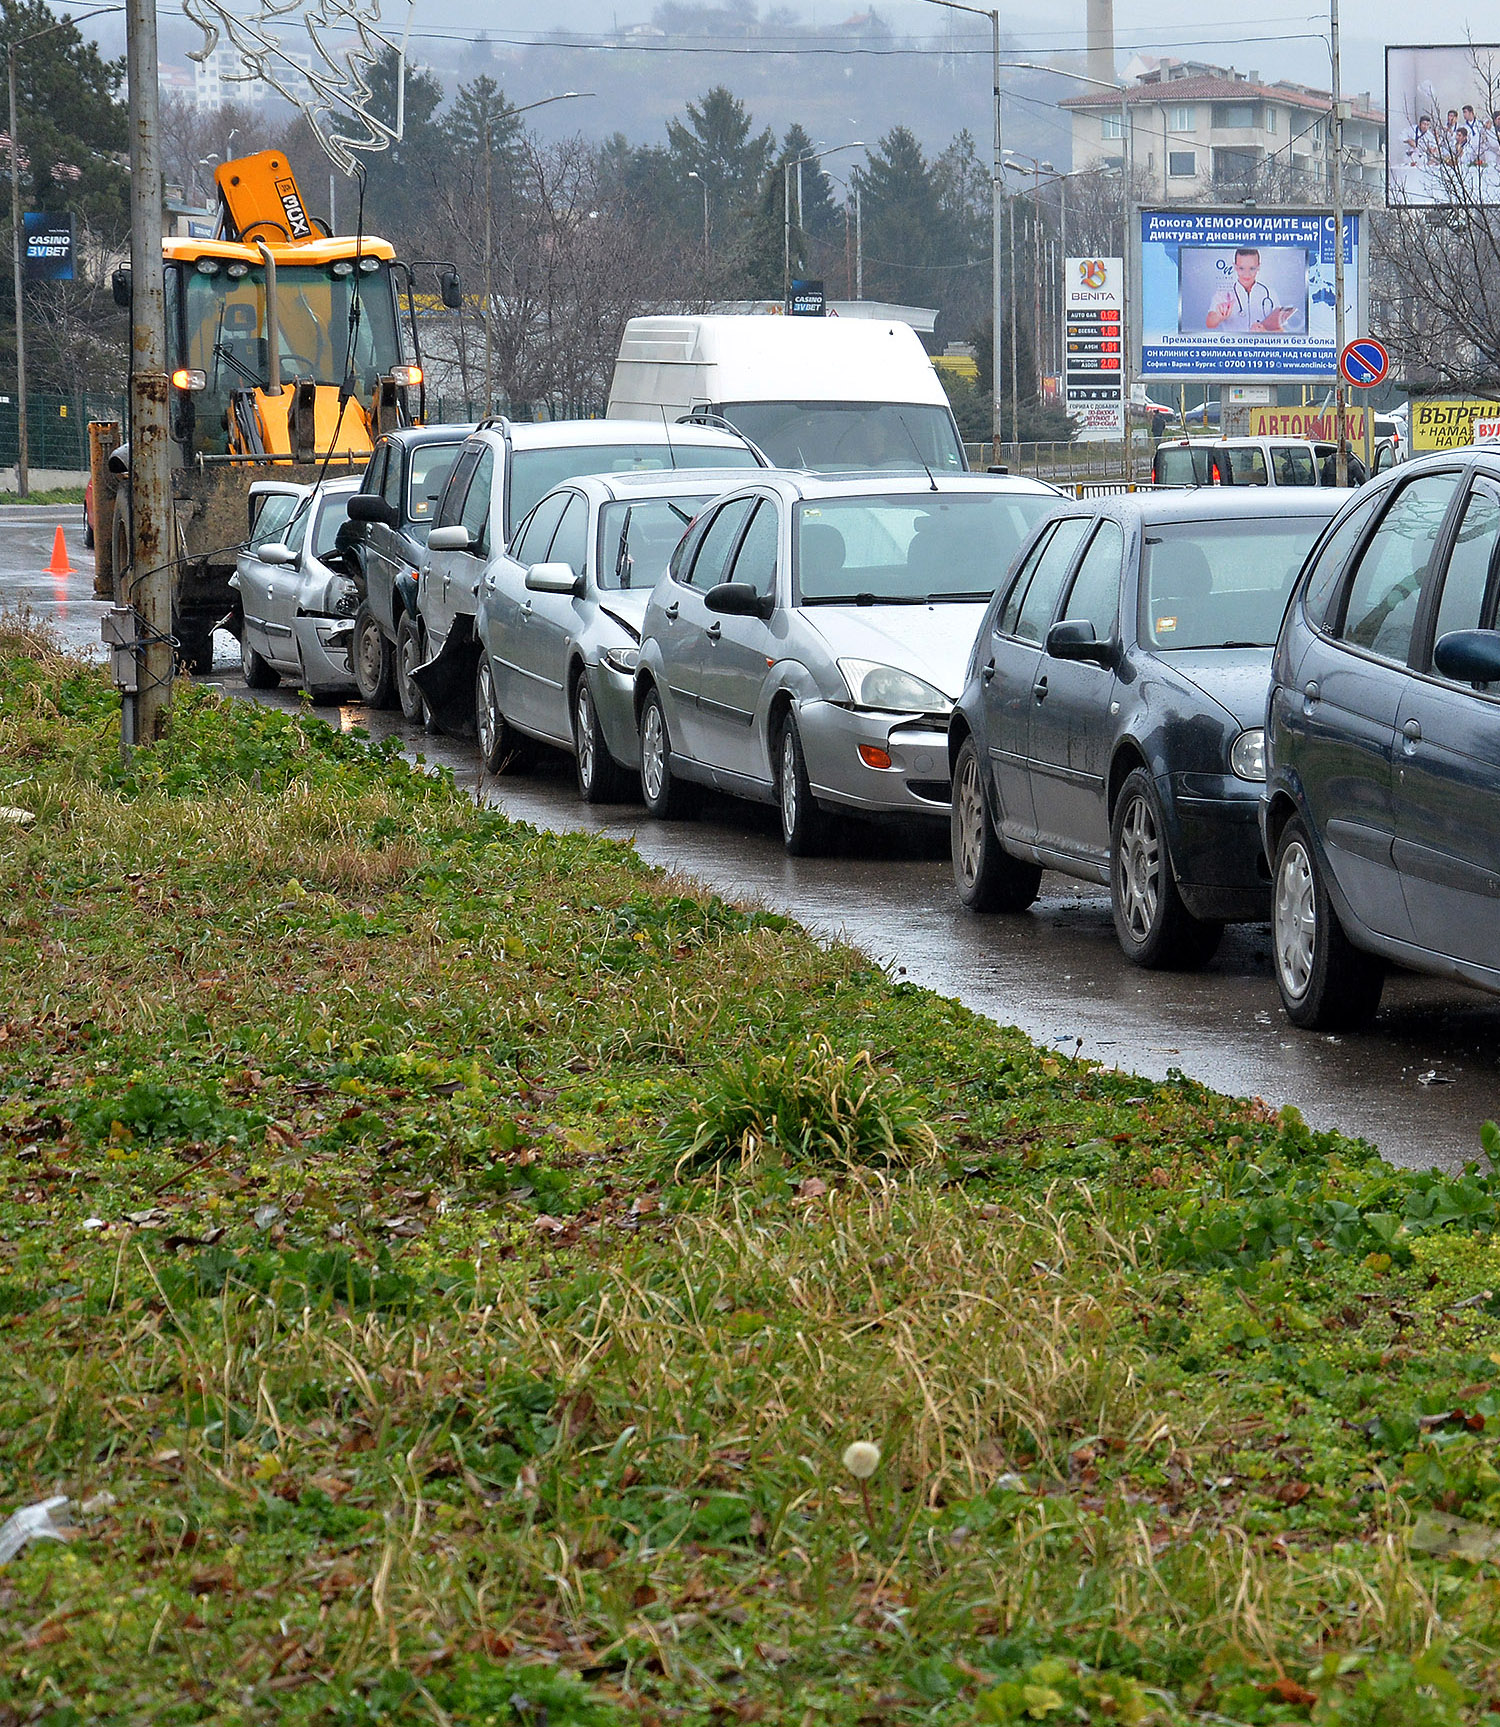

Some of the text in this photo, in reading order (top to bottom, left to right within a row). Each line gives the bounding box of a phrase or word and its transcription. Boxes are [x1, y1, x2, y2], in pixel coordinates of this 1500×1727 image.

[282, 195, 309, 234] 3CX
[1150, 217, 1319, 230] Докога ХЕМОРОИДИТЕ ще
[28, 236, 70, 245] CASINO
[1150, 231, 1319, 243] диктуват дневния ти ритъм?
[1162, 335, 1218, 344] Премахване
[1220, 336, 1235, 344] без
[1237, 337, 1281, 346] операция
[1291, 337, 1306, 345] без
[1308, 337, 1335, 345] болка
[1200, 350, 1237, 358] ФИЛИАЛА
[1282, 351, 1298, 359] НАД
[1147, 361, 1167, 369] София
[1436, 437, 1453, 446] НА
